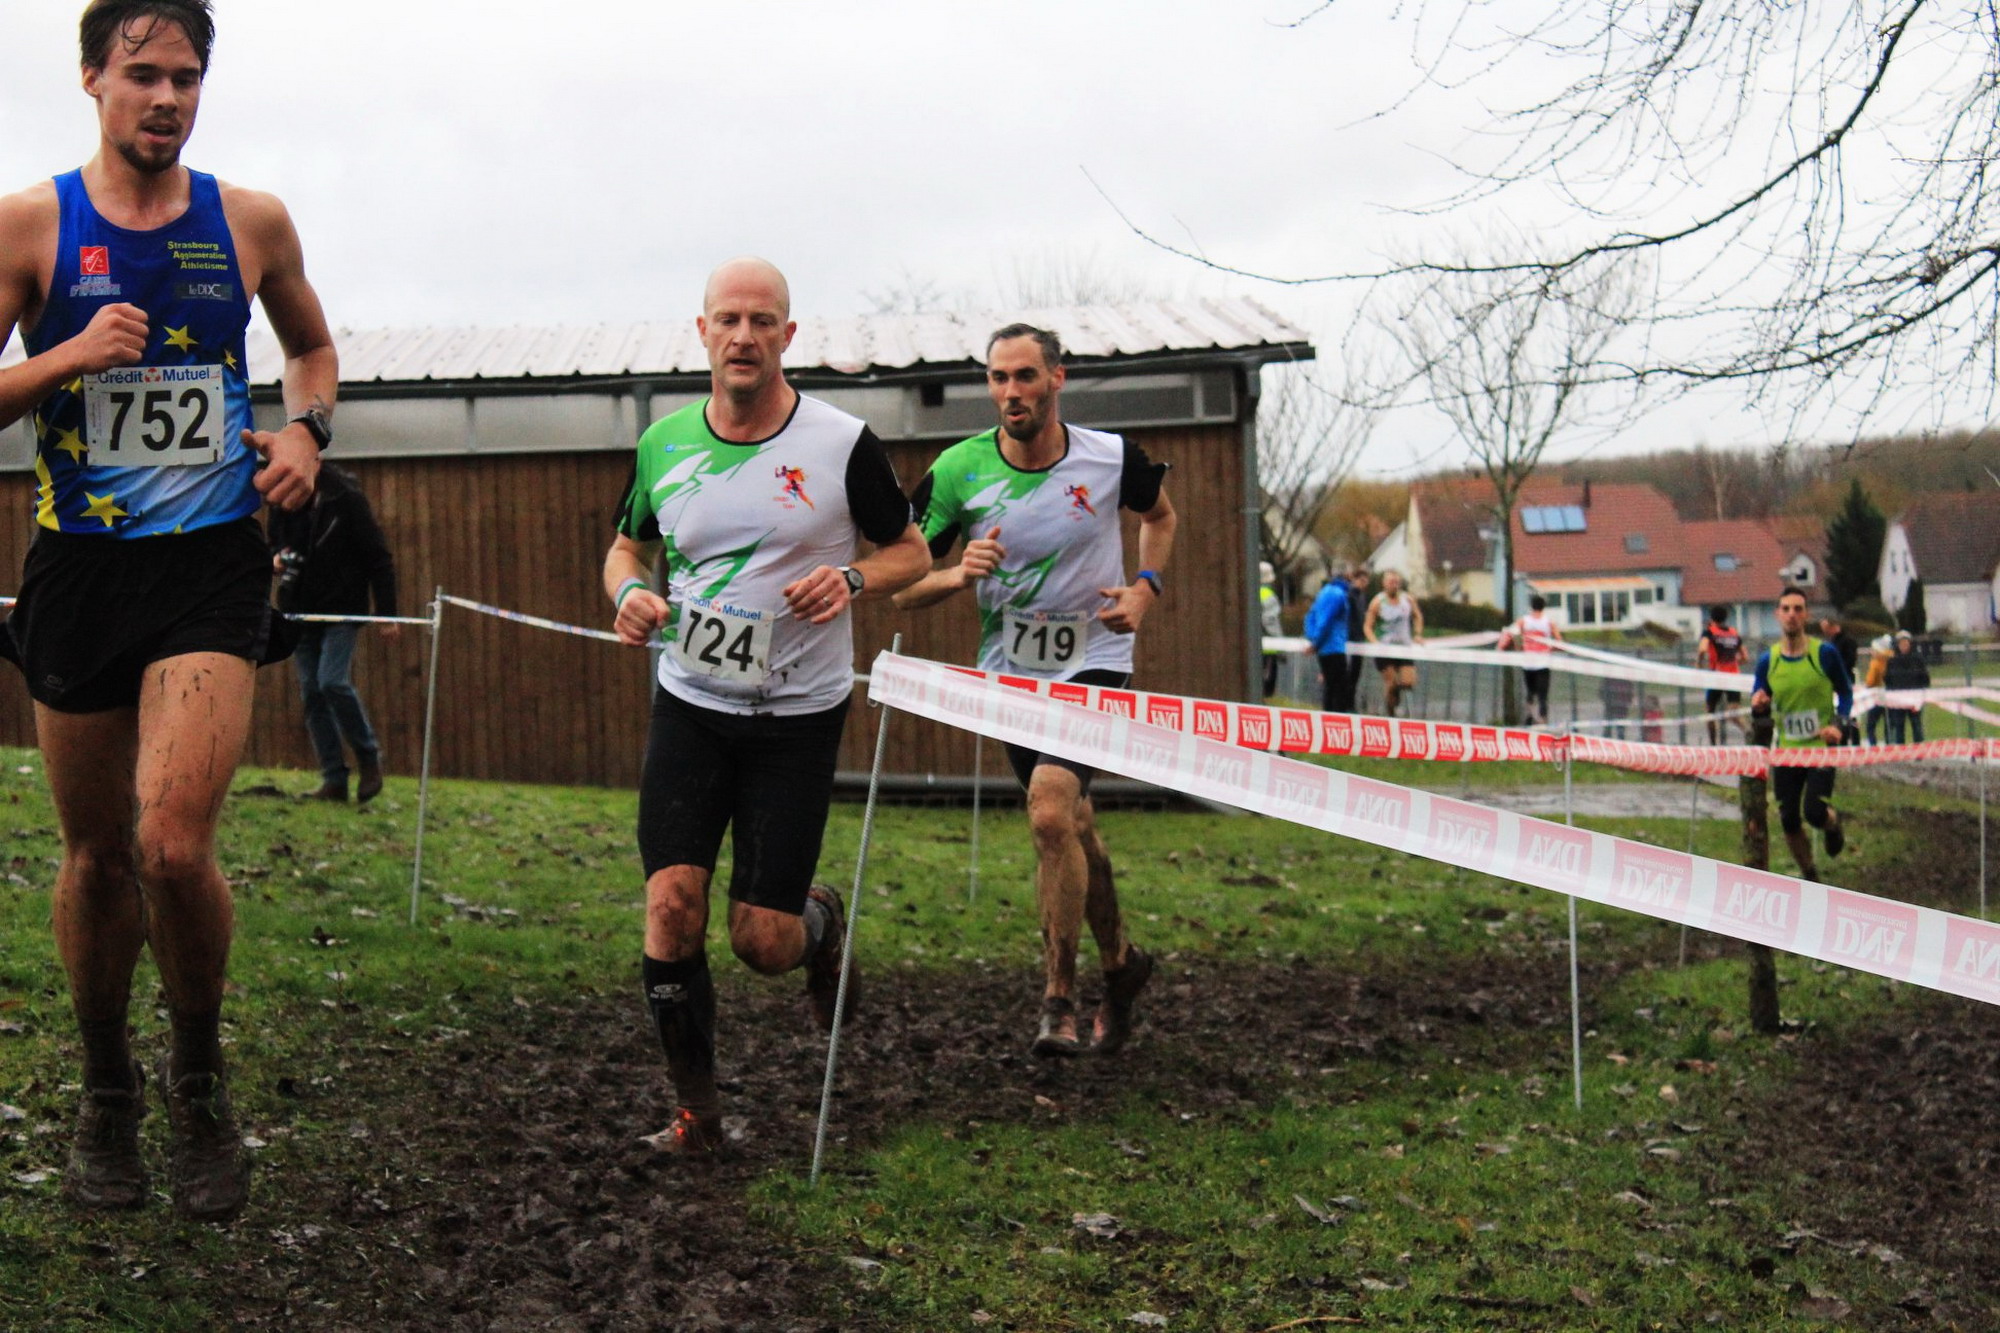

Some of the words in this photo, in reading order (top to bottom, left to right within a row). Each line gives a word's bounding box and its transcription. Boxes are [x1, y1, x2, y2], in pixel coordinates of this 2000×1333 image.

[167, 241, 220, 251] Strasbourg
[180, 260, 229, 271] Athletisme
[97, 369, 143, 384] Crédit
[162, 367, 210, 382] Mutuel
[109, 387, 210, 452] 752
[722, 604, 762, 621] Mutuel
[682, 608, 755, 672] 724
[1013, 621, 1076, 662] 719
[1197, 708, 1224, 734] DNA
[1242, 719, 1267, 743] DNA
[1284, 718, 1310, 741] DNA
[1325, 727, 1352, 749] DNA
[1364, 724, 1390, 747] DNA
[1403, 733, 1427, 755] DNA
[1438, 731, 1463, 752] DNA
